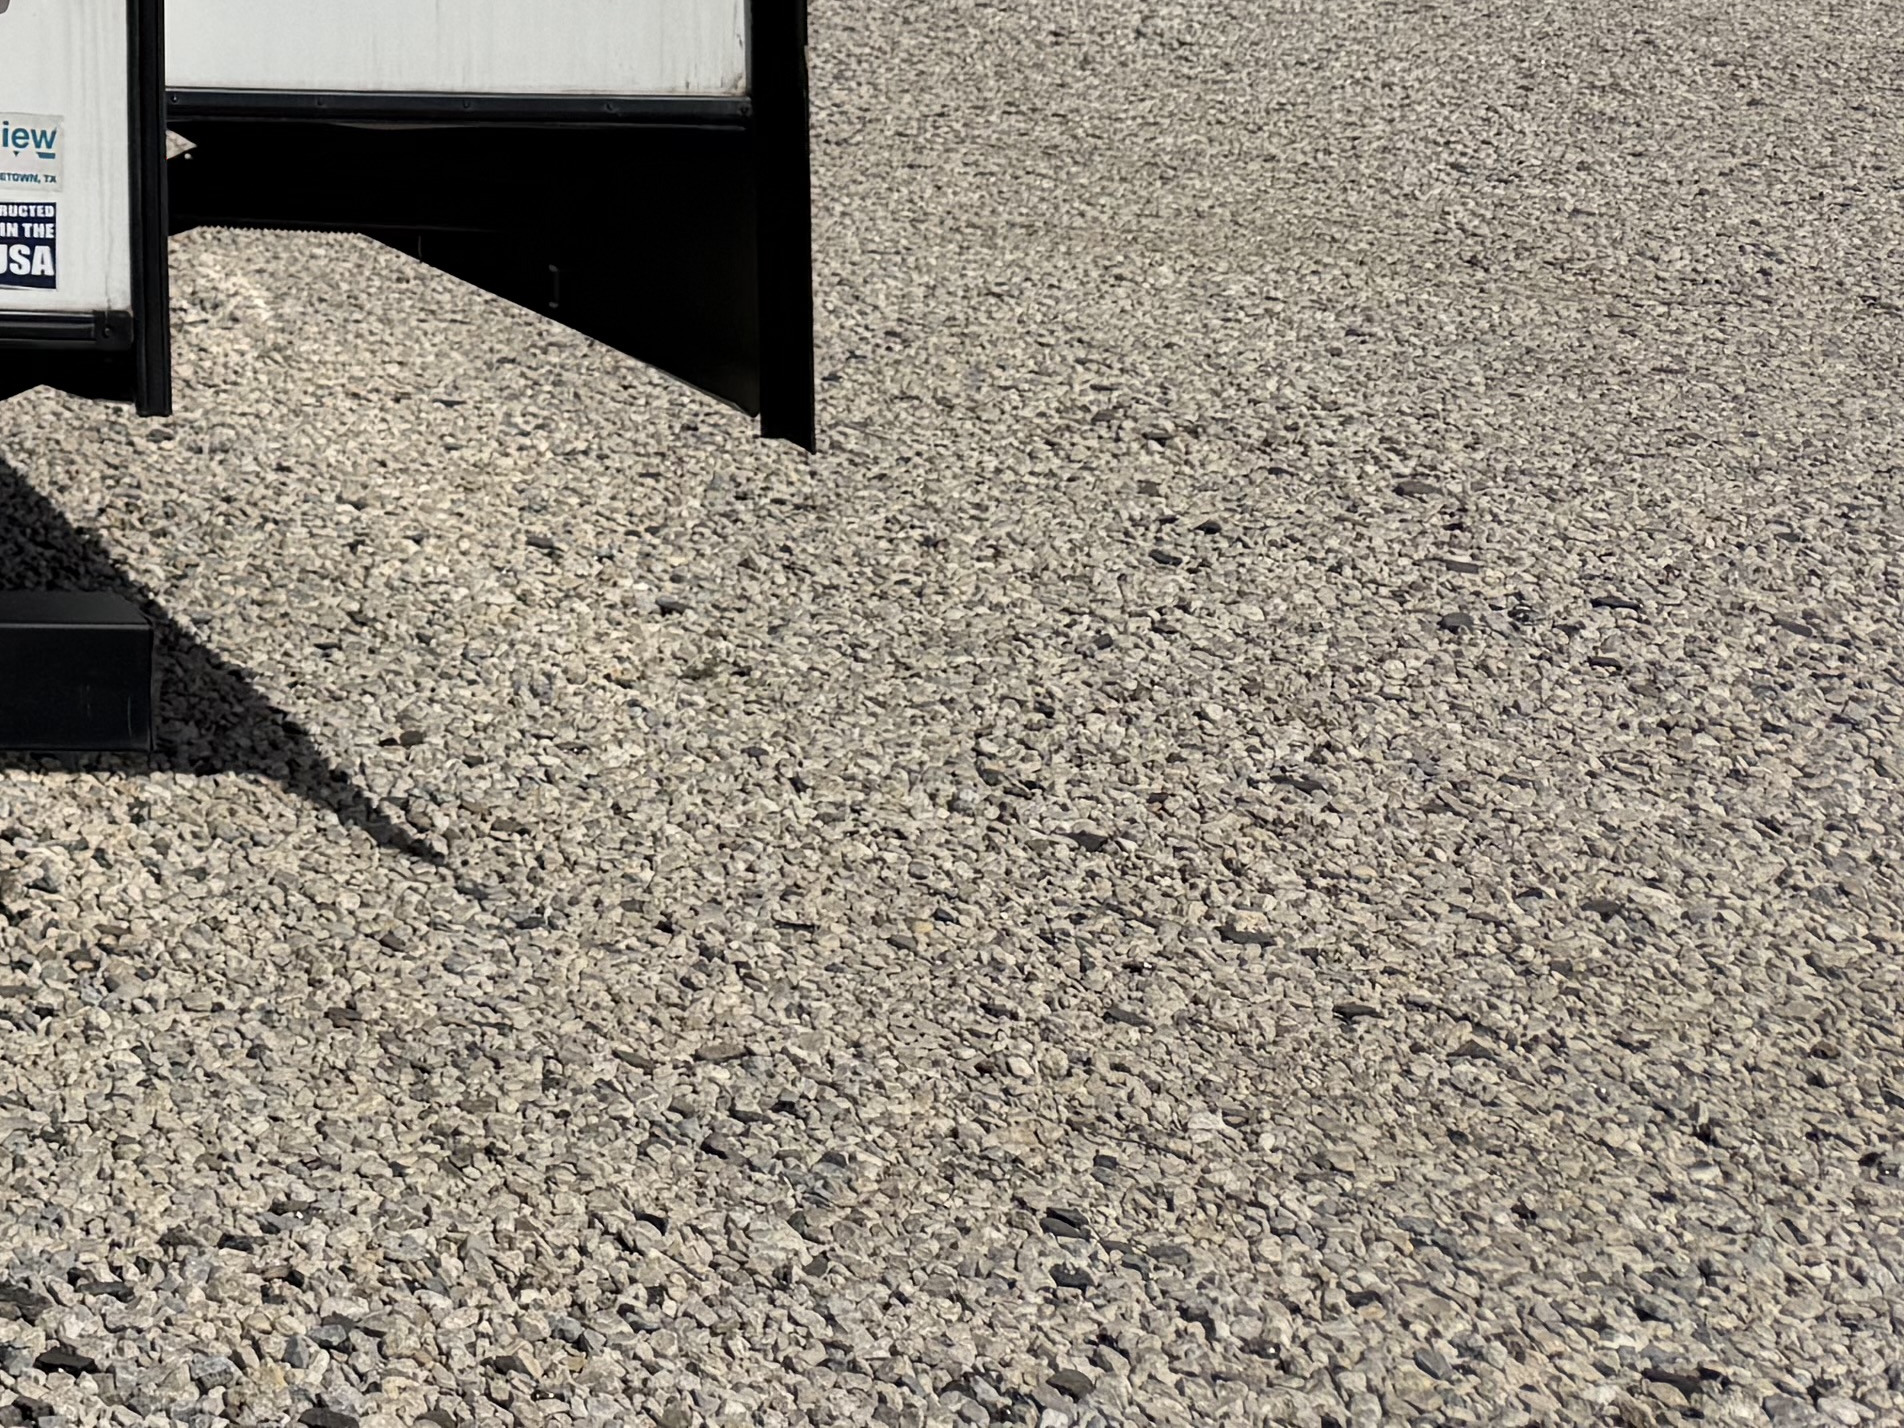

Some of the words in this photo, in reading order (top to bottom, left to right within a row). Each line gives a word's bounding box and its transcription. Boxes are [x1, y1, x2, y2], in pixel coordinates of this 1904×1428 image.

[43, 173, 57, 183] TX
[0, 222, 18, 238] IN
[22, 223, 55, 239] THE
